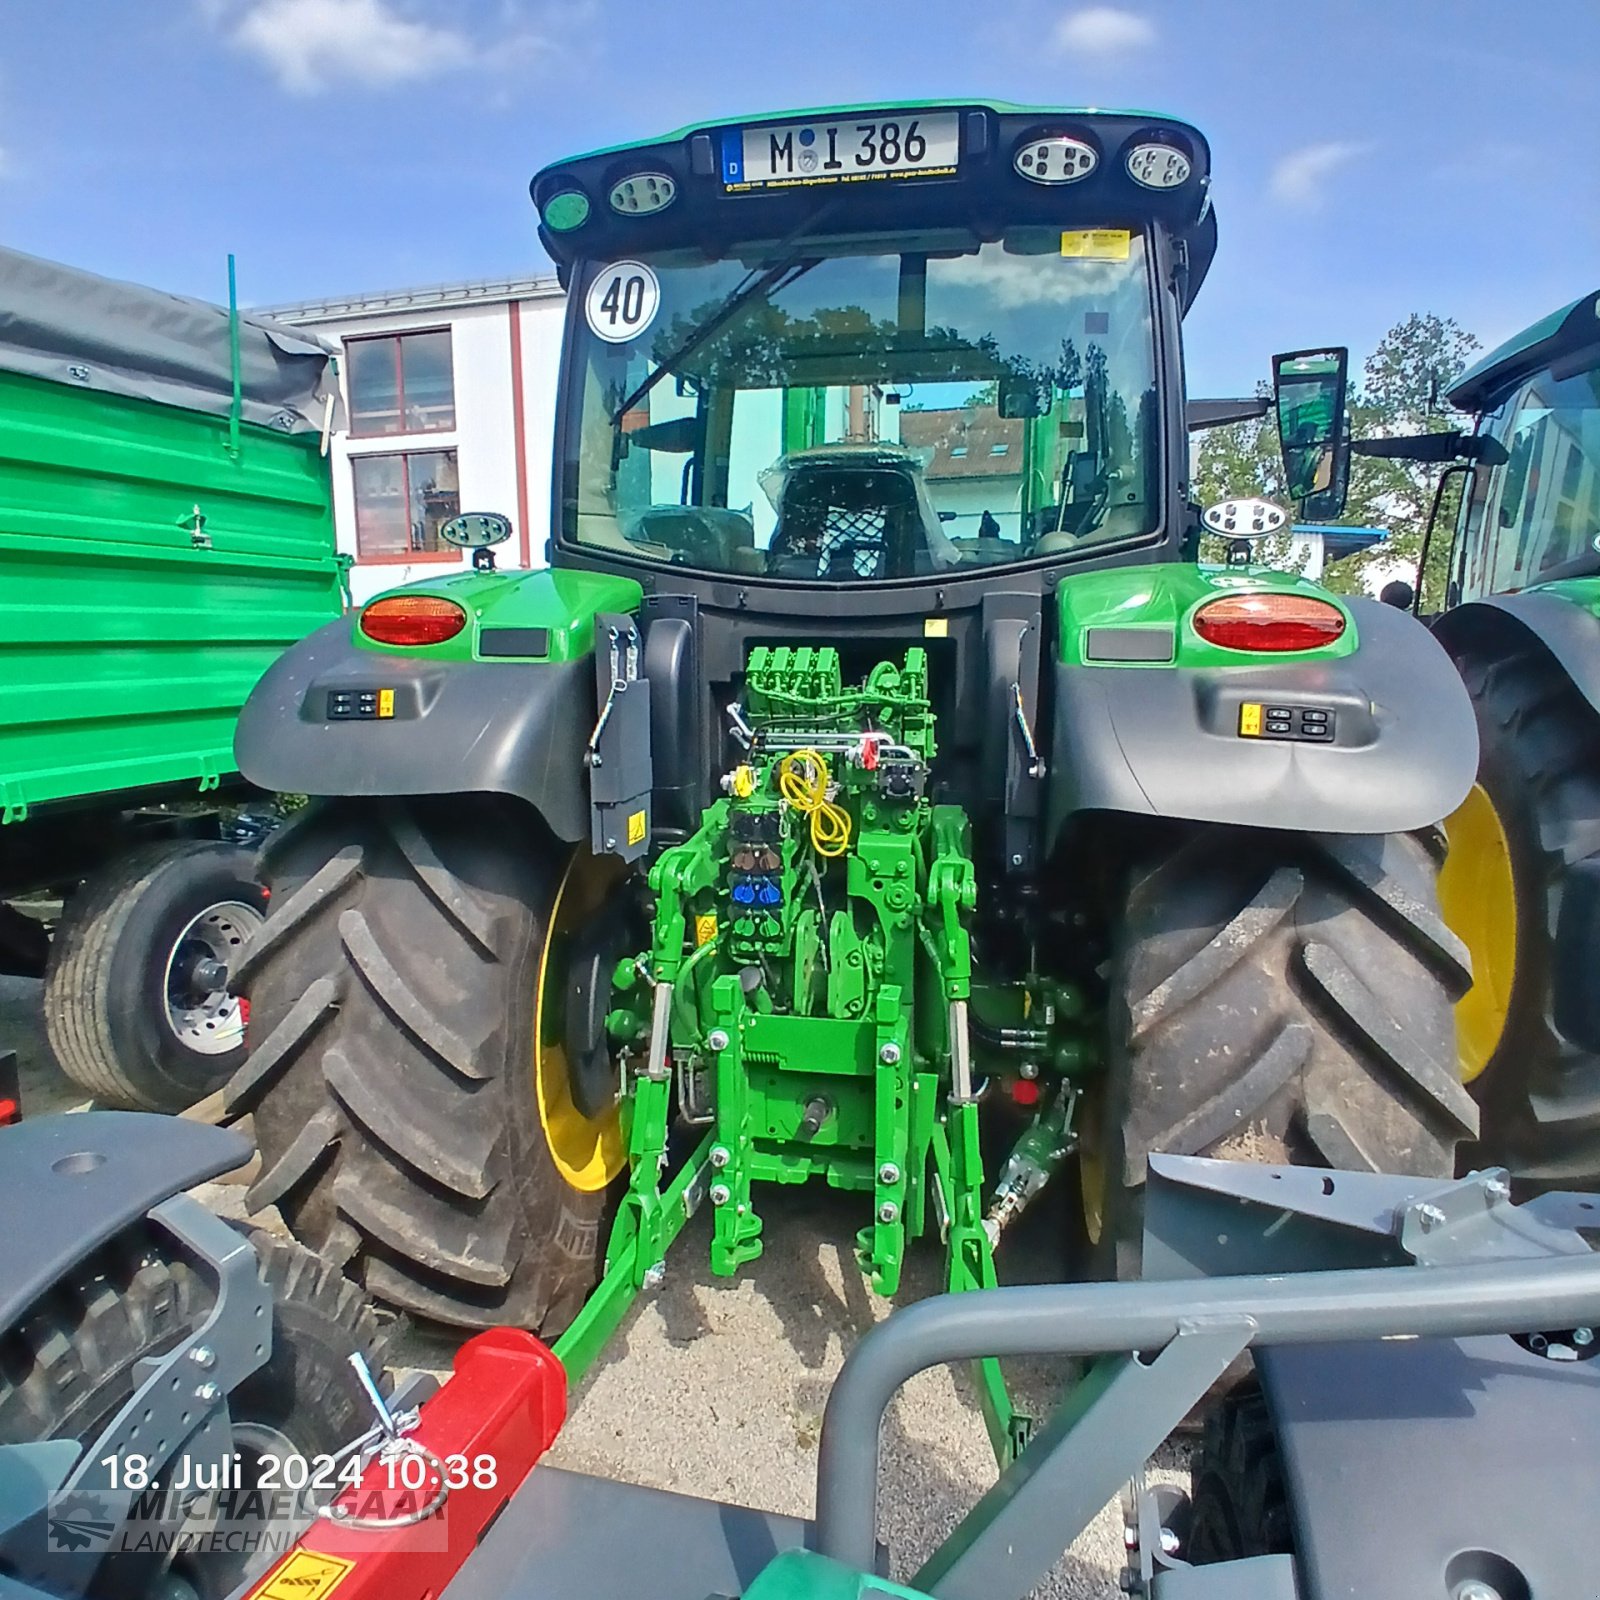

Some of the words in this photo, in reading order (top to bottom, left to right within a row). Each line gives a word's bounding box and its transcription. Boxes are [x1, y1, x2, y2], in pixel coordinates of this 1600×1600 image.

[729, 162, 738, 175] D
[769, 131, 793, 174] M
[823, 127, 843, 170] I
[855, 120, 927, 167] 386
[600, 275, 645, 325] 40
